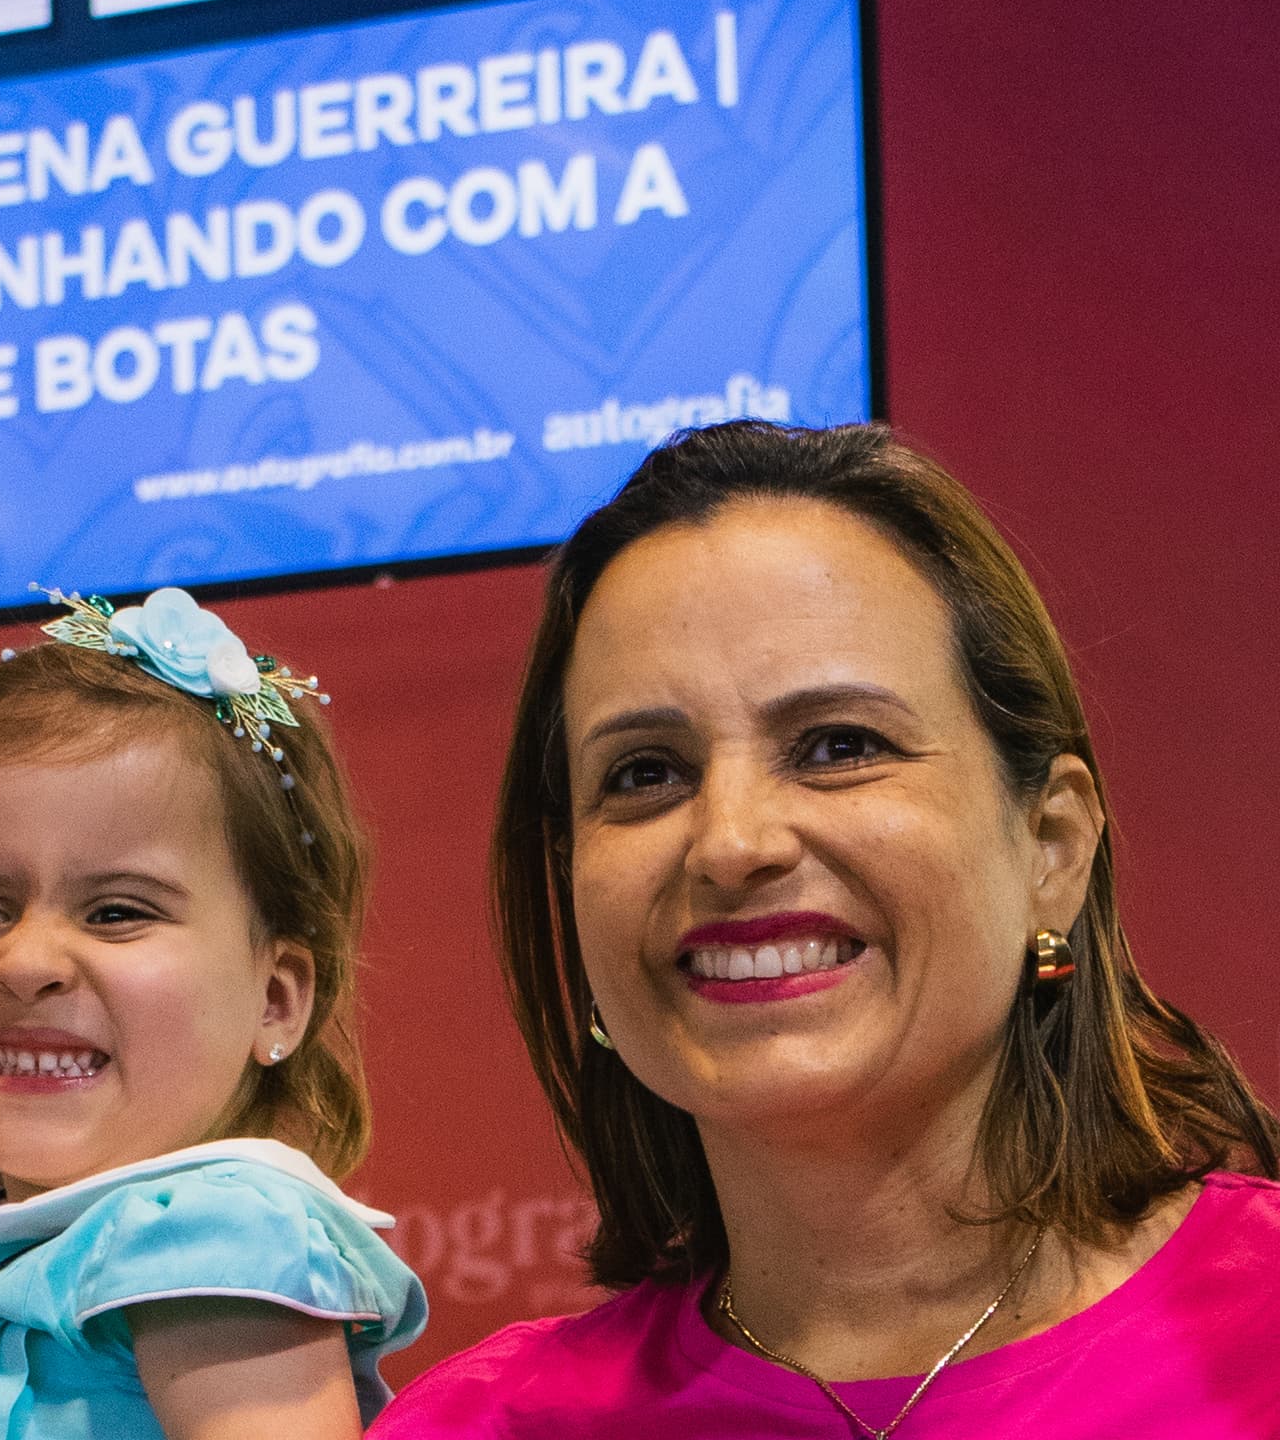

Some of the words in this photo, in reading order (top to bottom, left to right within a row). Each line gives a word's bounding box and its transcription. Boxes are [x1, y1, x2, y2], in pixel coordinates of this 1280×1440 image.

[166, 29, 699, 178] GUERREIRA
[381, 151, 597, 255] COM
[613, 142, 690, 226] A
[35, 305, 322, 414] BOTAS
